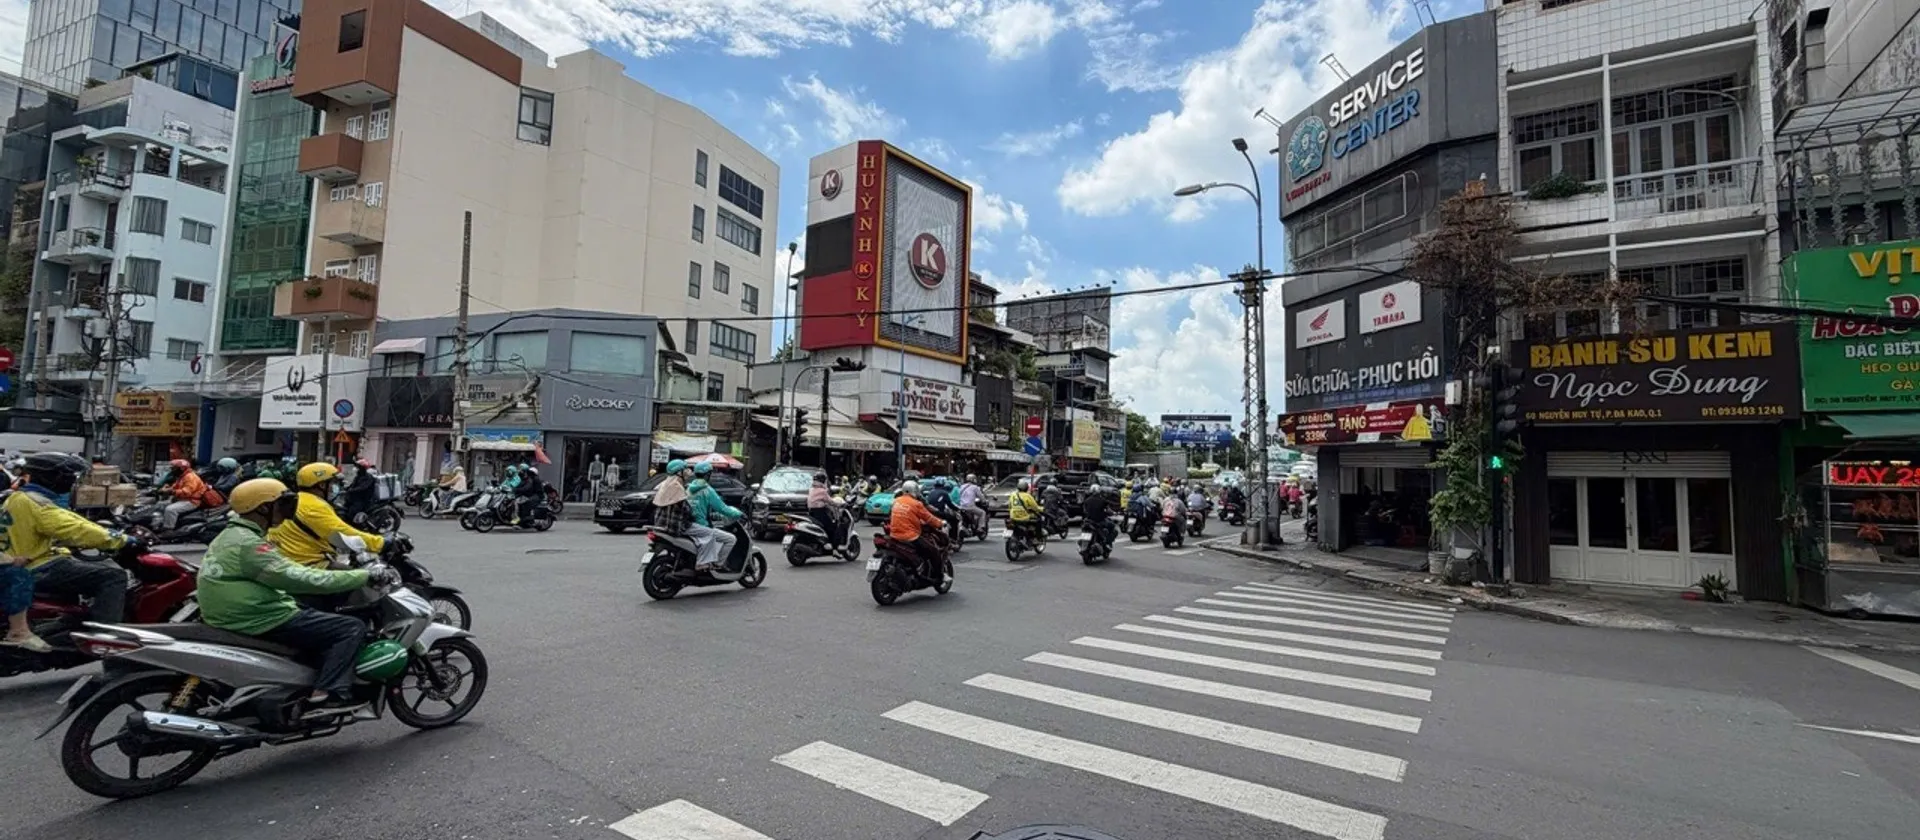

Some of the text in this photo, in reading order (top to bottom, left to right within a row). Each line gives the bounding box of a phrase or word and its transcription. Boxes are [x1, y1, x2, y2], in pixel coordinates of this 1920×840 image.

[1329, 47, 1425, 128] SERVICE
[1331, 89, 1421, 160] CENTER
[825, 174, 836, 189] K
[859, 155, 876, 252] HUỲNH
[920, 239, 940, 271] K
[855, 287, 870, 328] KÝ
[1373, 311, 1405, 326] YAMAHA
[1306, 333, 1334, 343] HONDA
[1530, 331, 1773, 368] BÁNH SU KEM
[1285, 373, 1311, 398] SỬA
[1312, 368, 1350, 395] CHỮA
[1358, 361, 1403, 388] PHỤC
[1407, 345, 1439, 381] HỒI
[1861, 363, 1892, 373] HEO
[1533, 364, 1768, 407] Ngọc Dung
[419, 414, 453, 423] VERA
[582, 398, 635, 410] JOCKEY
[1338, 414, 1367, 433] TẶNG
